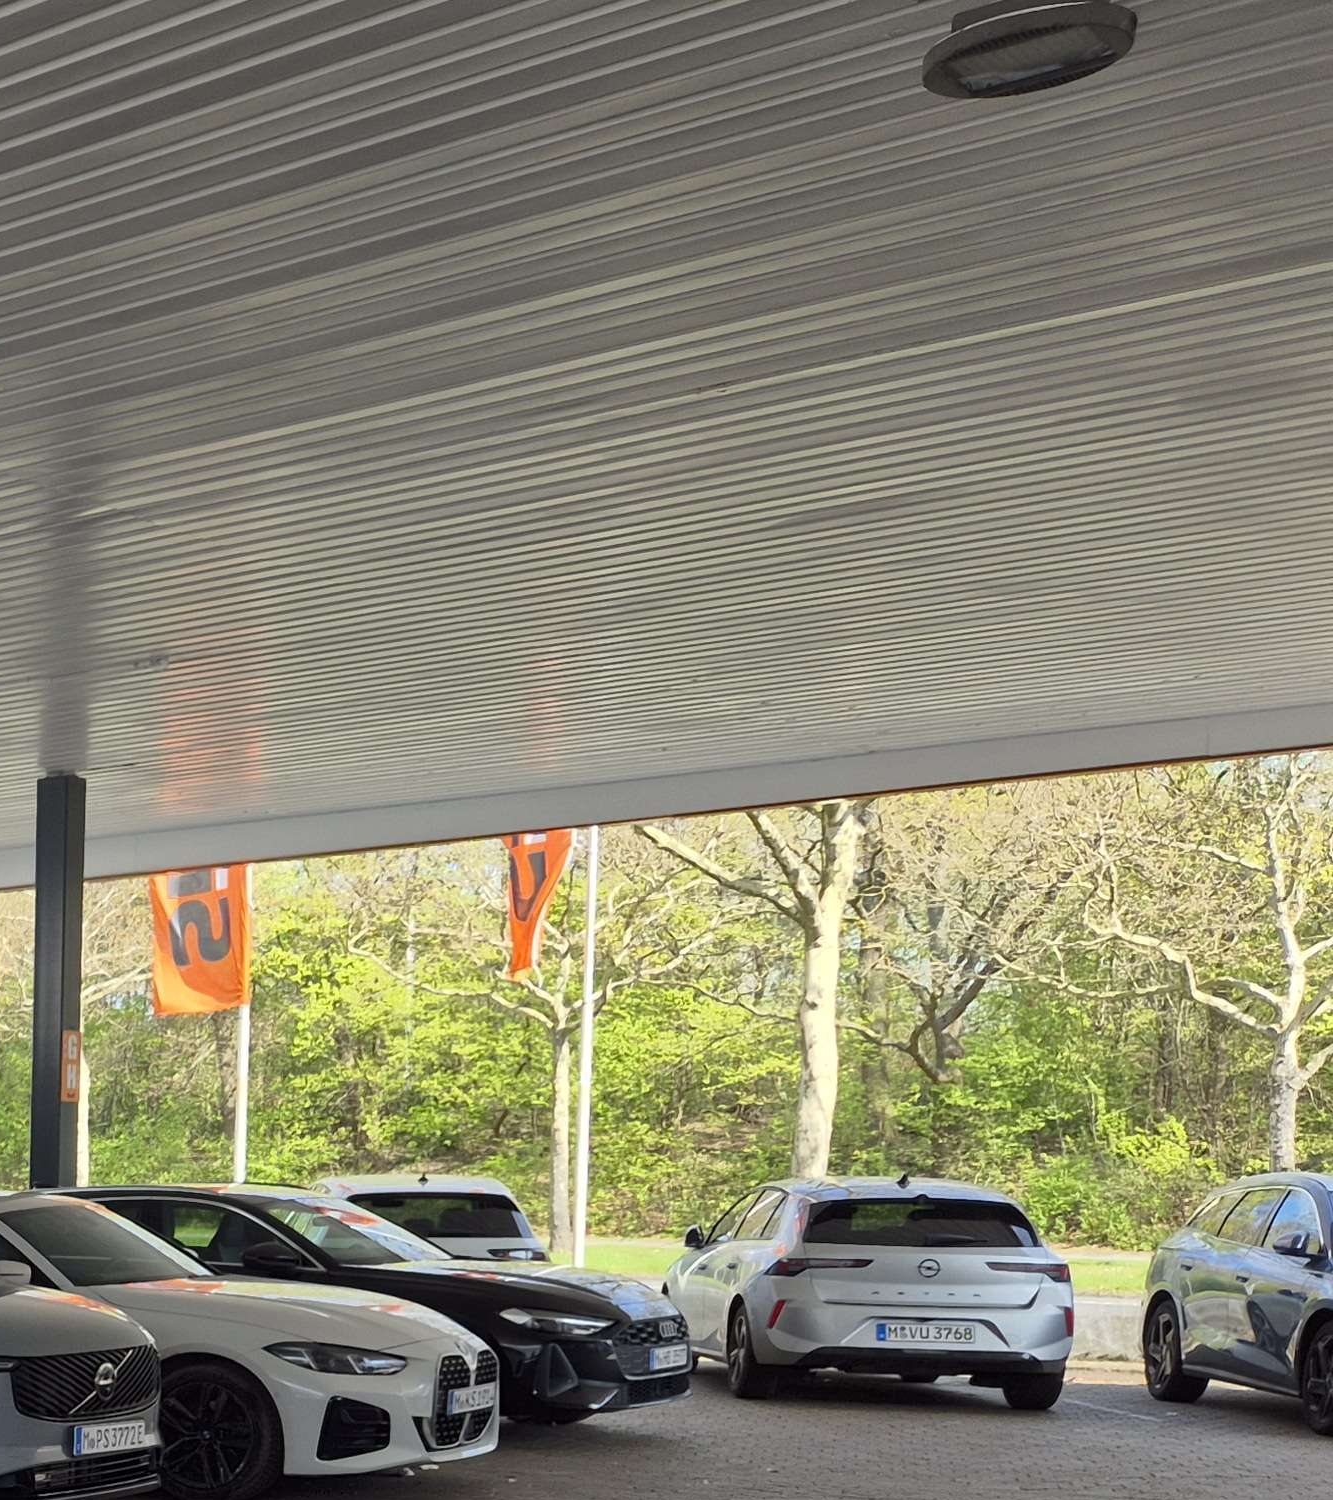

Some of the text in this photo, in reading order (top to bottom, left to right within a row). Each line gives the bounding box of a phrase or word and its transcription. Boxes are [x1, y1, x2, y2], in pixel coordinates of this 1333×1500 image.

[887, 1326, 973, 1341] M VU 3768
